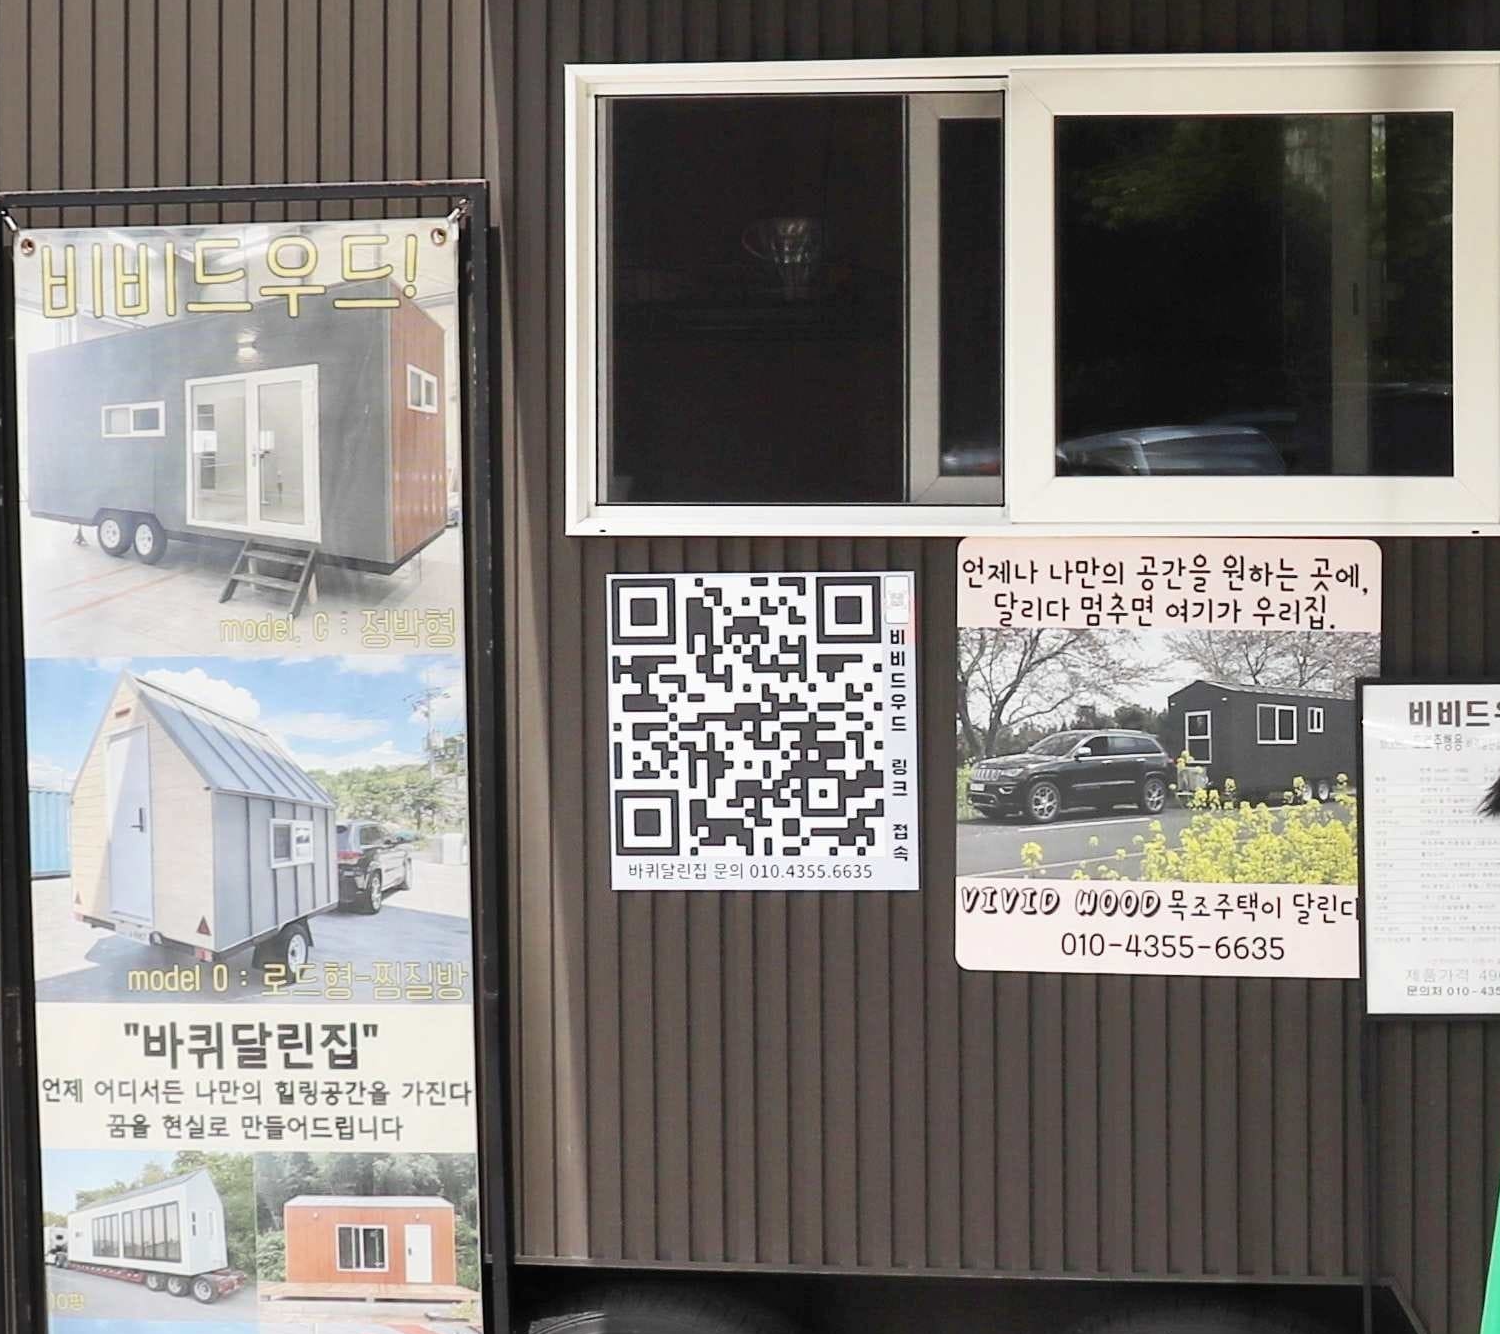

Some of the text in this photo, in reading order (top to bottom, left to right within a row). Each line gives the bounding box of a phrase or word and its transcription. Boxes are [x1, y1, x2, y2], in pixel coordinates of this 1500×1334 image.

[41, 233, 419, 319] 비비드우드!
[962, 554, 1369, 595] 언제나 나만의 공간을 원하는 곳에,
[994, 591, 1337, 630] 달리다 멈추면 여기가 우리집.
[360, 608, 457, 649] 정박형
[890, 630, 909, 861] 비비드우드 링크 접속
[628, 862, 873, 880] 바퀴달린집 문의 010.4355.6635
[960, 887, 1061, 915] VIVID
[1075, 889, 1162, 917] WOOD
[1167, 890, 1282, 922] 목조주택이
[1060, 932, 1286, 961] 010-4355-6635
[127, 964, 201, 994] model
[41, 1078, 473, 1108] 언제 어디서든 나만의 힐링공간을 가진다
[107, 1114, 404, 1142] 꿈을 현실로 만들어드립니다
